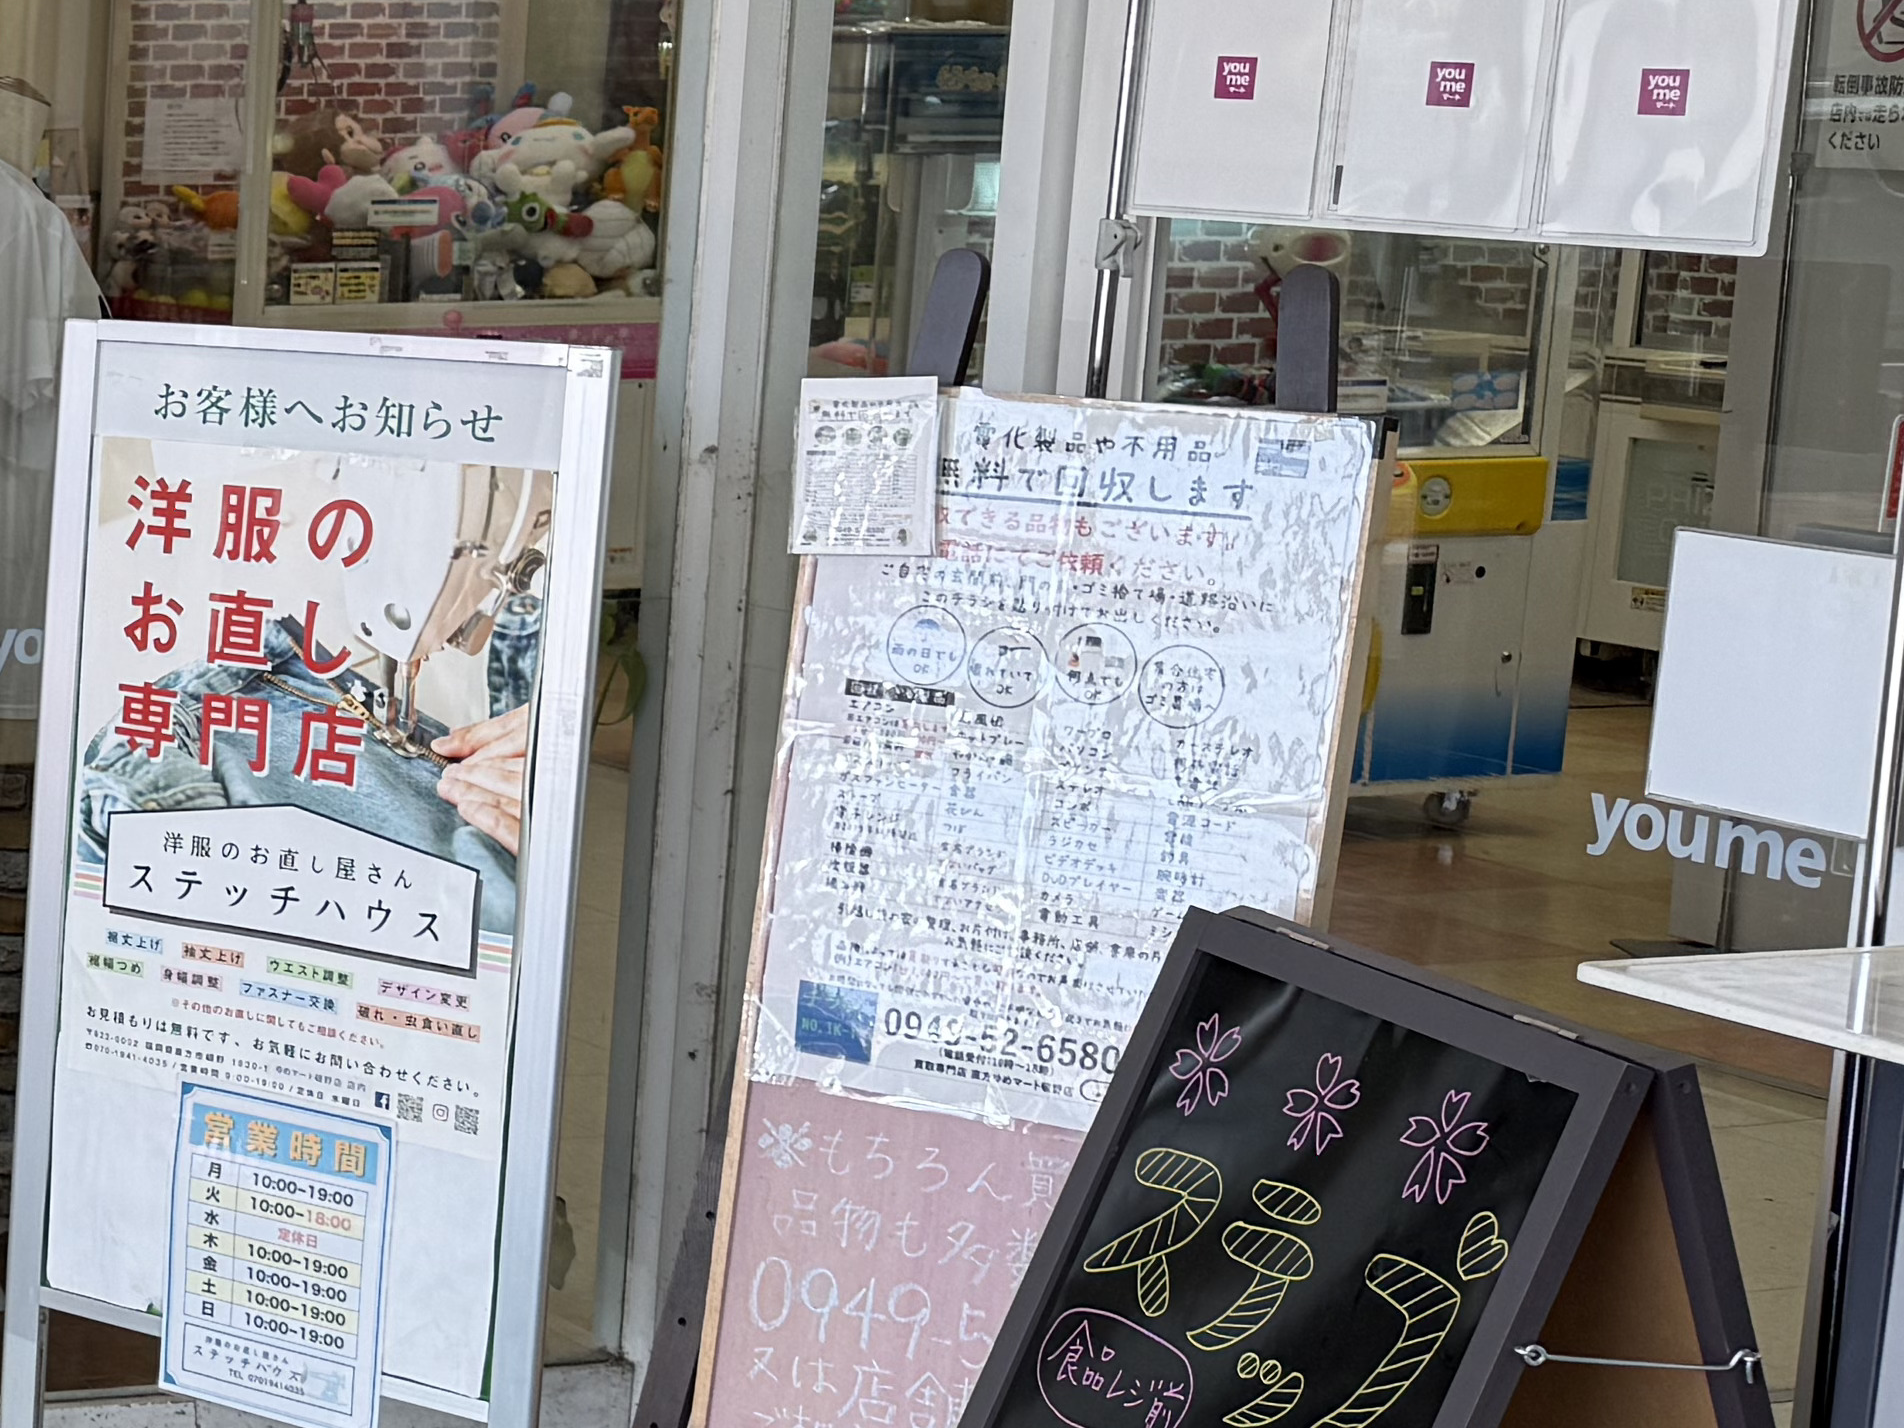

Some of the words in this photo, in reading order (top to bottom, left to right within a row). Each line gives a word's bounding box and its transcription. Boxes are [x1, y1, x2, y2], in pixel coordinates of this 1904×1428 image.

[1222, 60, 1250, 77] you
[1435, 66, 1467, 83] you
[1226, 73, 1250, 87] me
[1439, 79, 1467, 93] me
[1647, 71, 1682, 90] you
[1832, 73, 1904, 98] 転倒事故防
[1651, 86, 1682, 101] me
[1827, 131, 1881, 153] ください
[152, 381, 504, 444] お客様へお知らせ
[972, 421, 1214, 464] 電化製品や不用品
[124, 474, 375, 569] 洋服の
[123, 580, 352, 679] お直し
[114, 680, 368, 789] 専門店
[1586, 792, 1827, 889] youme
[162, 828, 414, 891] 洋服のお直し屋さん
[128, 863, 441, 943] ステッチハウス
[202, 1110, 369, 1180] 営業時間
[206, 1161, 225, 1180] 月
[204, 1184, 222, 1204] 火
[203, 1208, 221, 1228] 水
[277, 1226, 319, 1250] 定休日
[202, 1231, 220, 1250] 木
[201, 1277, 218, 1295] 土
[201, 1300, 216, 1319] 日
